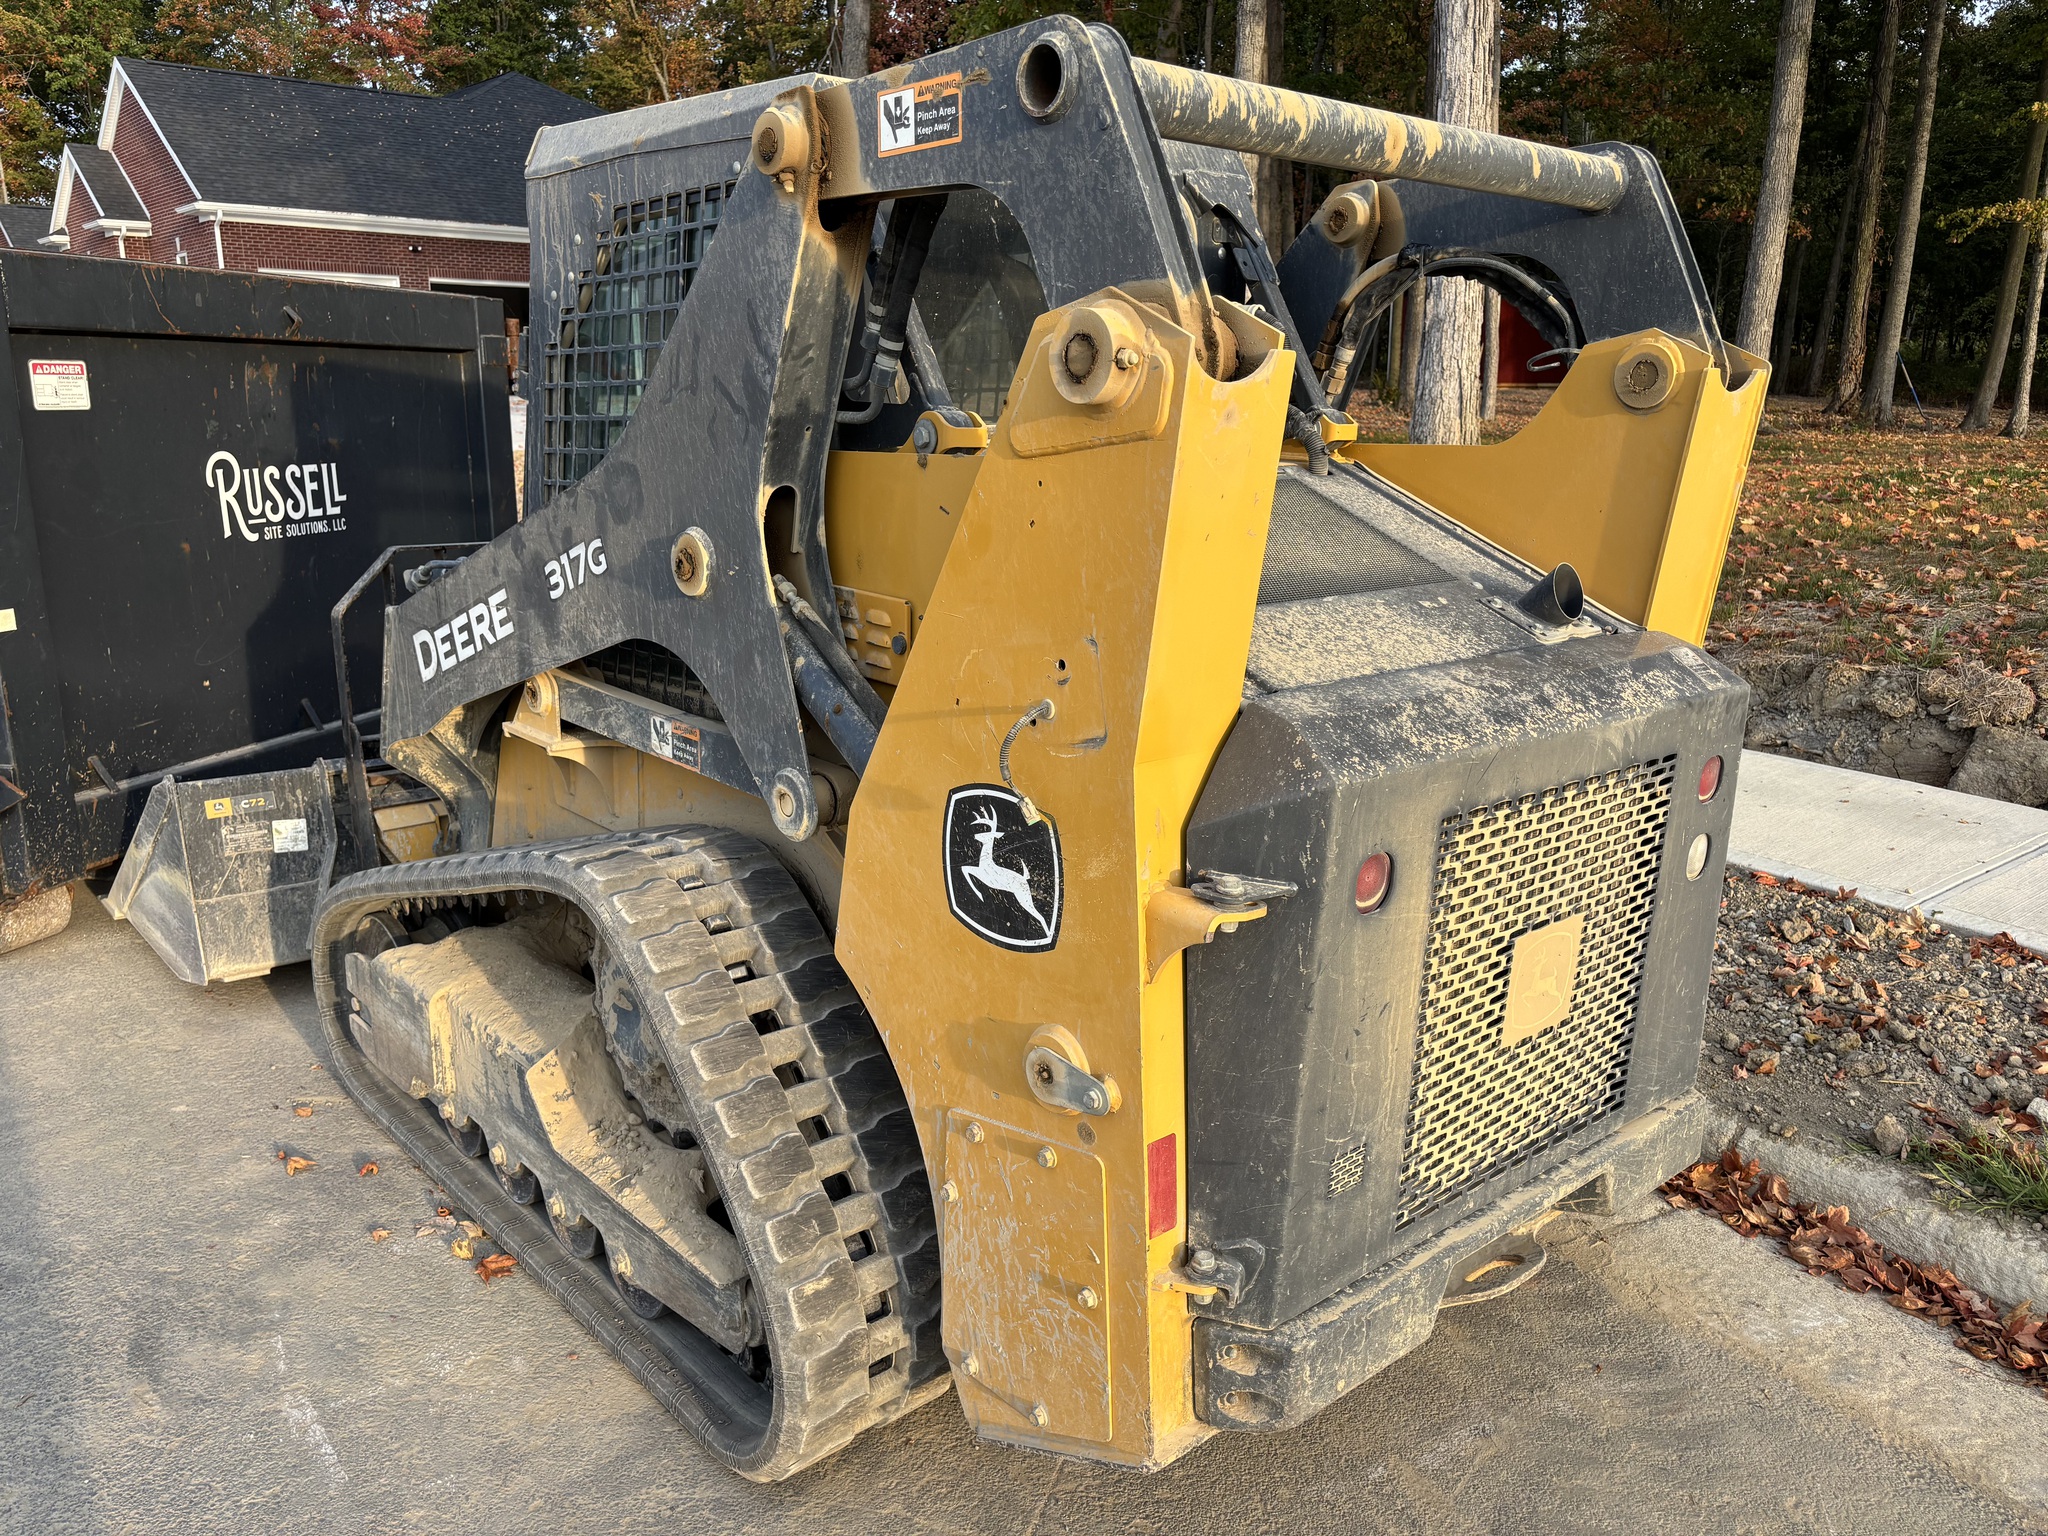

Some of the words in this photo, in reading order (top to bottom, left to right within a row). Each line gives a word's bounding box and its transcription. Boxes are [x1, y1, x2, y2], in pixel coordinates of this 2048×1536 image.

[917, 109, 938, 121] Pinch
[939, 106, 956, 117] Area
[917, 126, 933, 135] Keep
[934, 122, 951, 131] Away
[43, 365, 82, 374] DANGER
[205, 450, 347, 542] RUSSELL
[264, 525, 284, 540] SITE
[333, 518, 347, 531] LLC
[544, 538, 608, 600] 317G
[413, 588, 515, 683] DEERE
[241, 798, 265, 808] C72
